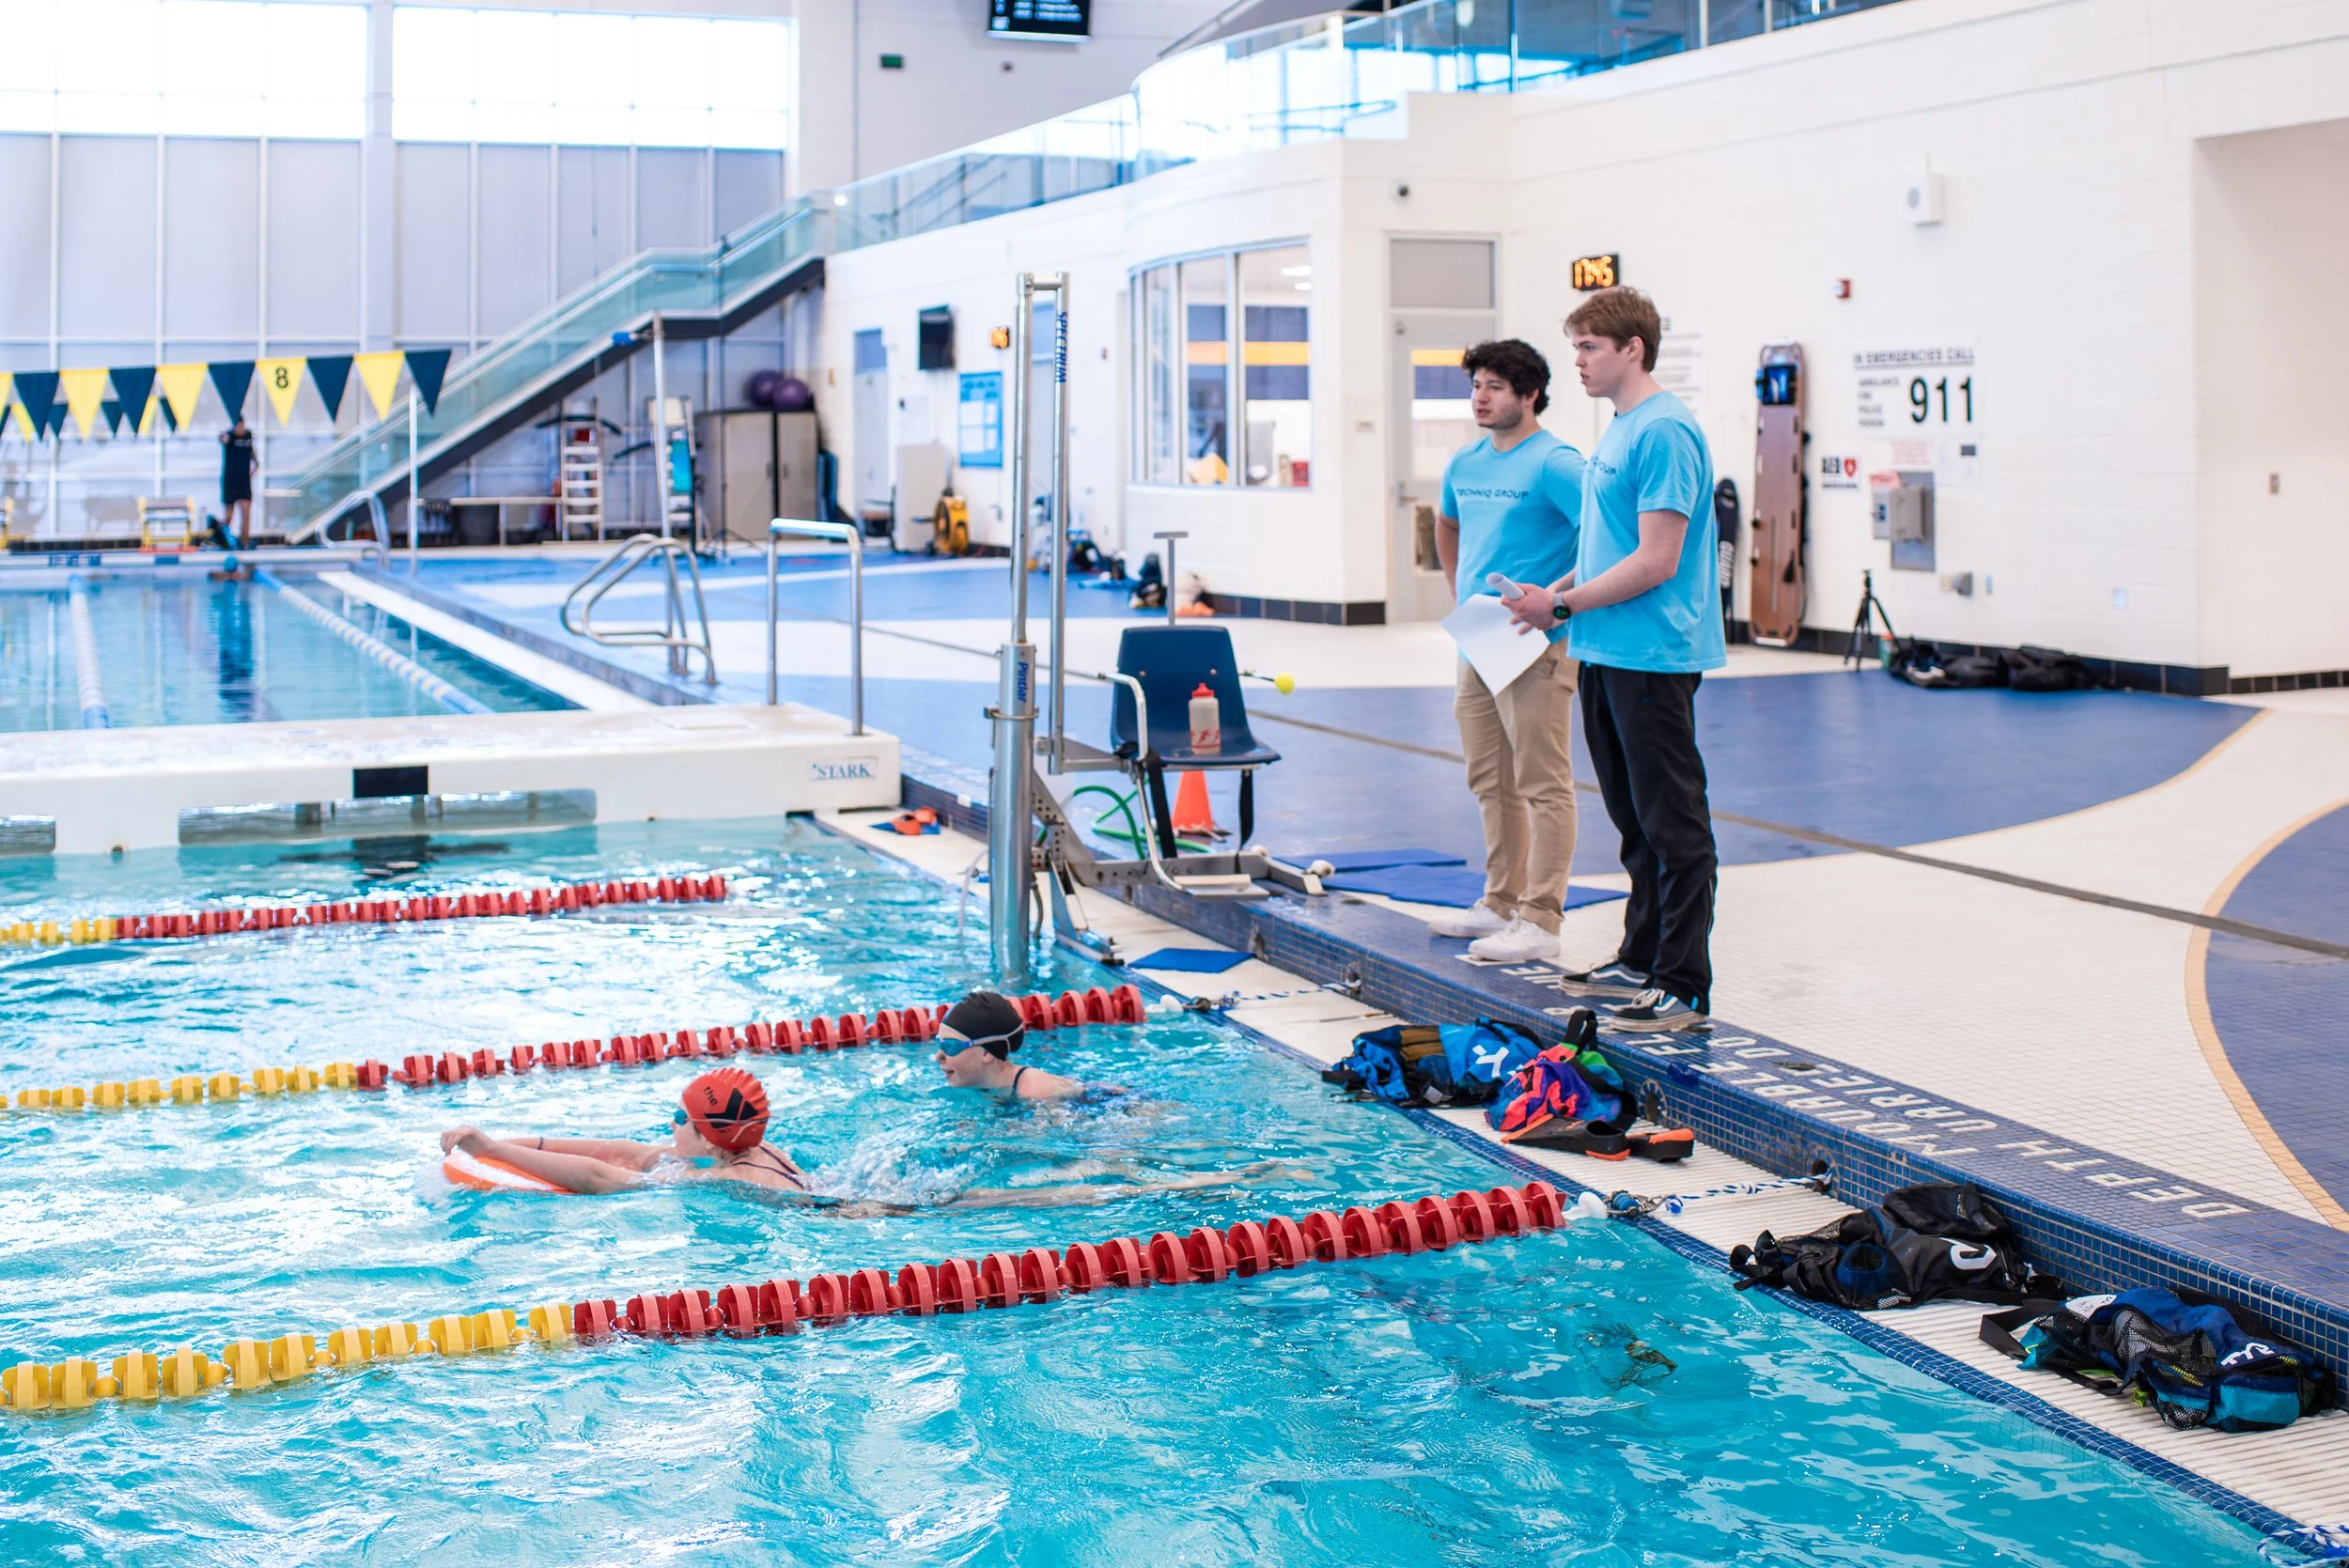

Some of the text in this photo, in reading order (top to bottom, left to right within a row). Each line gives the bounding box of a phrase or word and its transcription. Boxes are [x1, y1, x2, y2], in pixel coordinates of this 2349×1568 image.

[1055, 311, 1067, 382] SPECTRUM
[275, 366, 288, 389] 8
[1909, 377, 1972, 423] 911
[1456, 488, 1530, 500] TECHNIQ GROUP
[812, 763, 871, 779] STARK
[704, 1086, 719, 1107] the
[1995, 1140, 2252, 1219] DEPTH
